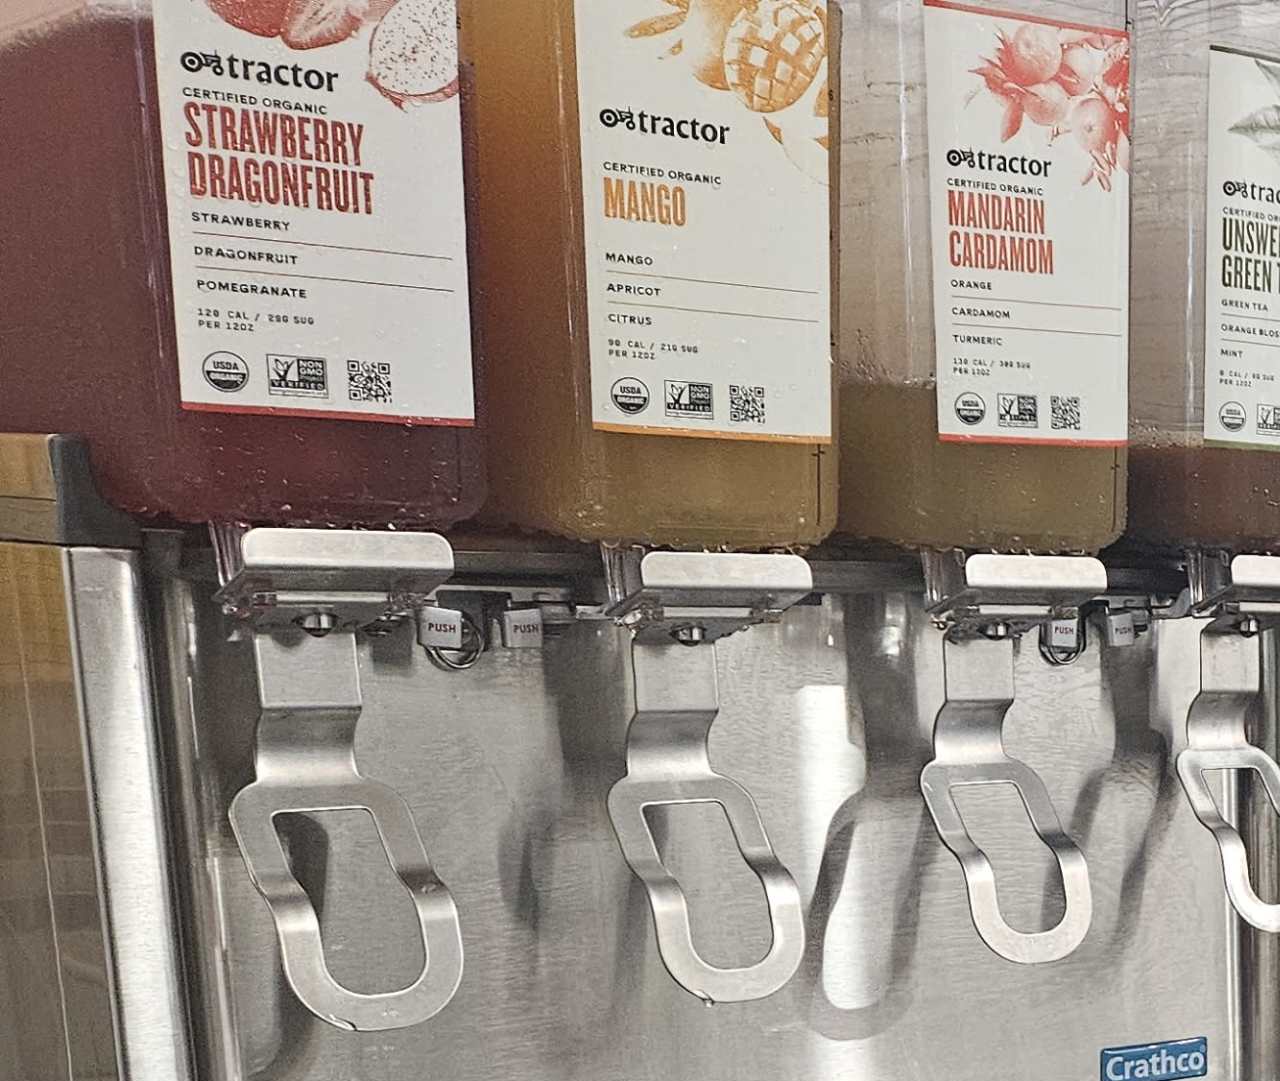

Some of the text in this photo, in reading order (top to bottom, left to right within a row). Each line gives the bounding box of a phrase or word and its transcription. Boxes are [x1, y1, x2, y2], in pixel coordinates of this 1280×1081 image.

[228, 53, 339, 92] tractor
[182, 87, 328, 116] CERTIFIED ORGANIC
[184, 101, 364, 166] STRAWBERRY
[638, 111, 730, 144] tractor
[979, 151, 1052, 177] tractor
[603, 161, 721, 185] CERTIFIED ORGANIC
[187, 151, 374, 214] DRAGONFRUIT
[947, 178, 1044, 196] CERTIFIED ORGANIC
[603, 177, 686, 227] MANGO
[948, 190, 1045, 234] MANDARIN
[1222, 206, 1265, 220] CERTIFIED
[191, 211, 290, 231] STRAWBERRY
[194, 246, 298, 265] DRAGONFRUIT
[949, 230, 1053, 275] CARDAMOM
[605, 253, 653, 266] MANGO
[1222, 255, 1272, 293] GREEN
[196, 279, 307, 299] POMEGRANATE
[607, 283, 662, 296] APRICOT
[950, 279, 992, 290] ORANGE
[1221, 299, 1268, 312] GREEN TEA
[228, 310, 248, 321] CAL
[608, 313, 652, 326] CITRUS
[952, 307, 1011, 319] CARDAMOM
[198, 320, 220, 330] PER
[1221, 324, 1256, 335] ORANGE
[628, 340, 645, 348] CAL
[953, 335, 1002, 346] TURMERIC
[608, 349, 628, 358] PER
[1220, 349, 1243, 358] MINT
[213, 360, 239, 371] USDA
[620, 385, 641, 395] USDA
[428, 622, 456, 633] PUSH
[513, 624, 539, 633] PUSH
[1054, 626, 1074, 635] PUSH
[1106, 1049, 1205, 1081] Crathco
